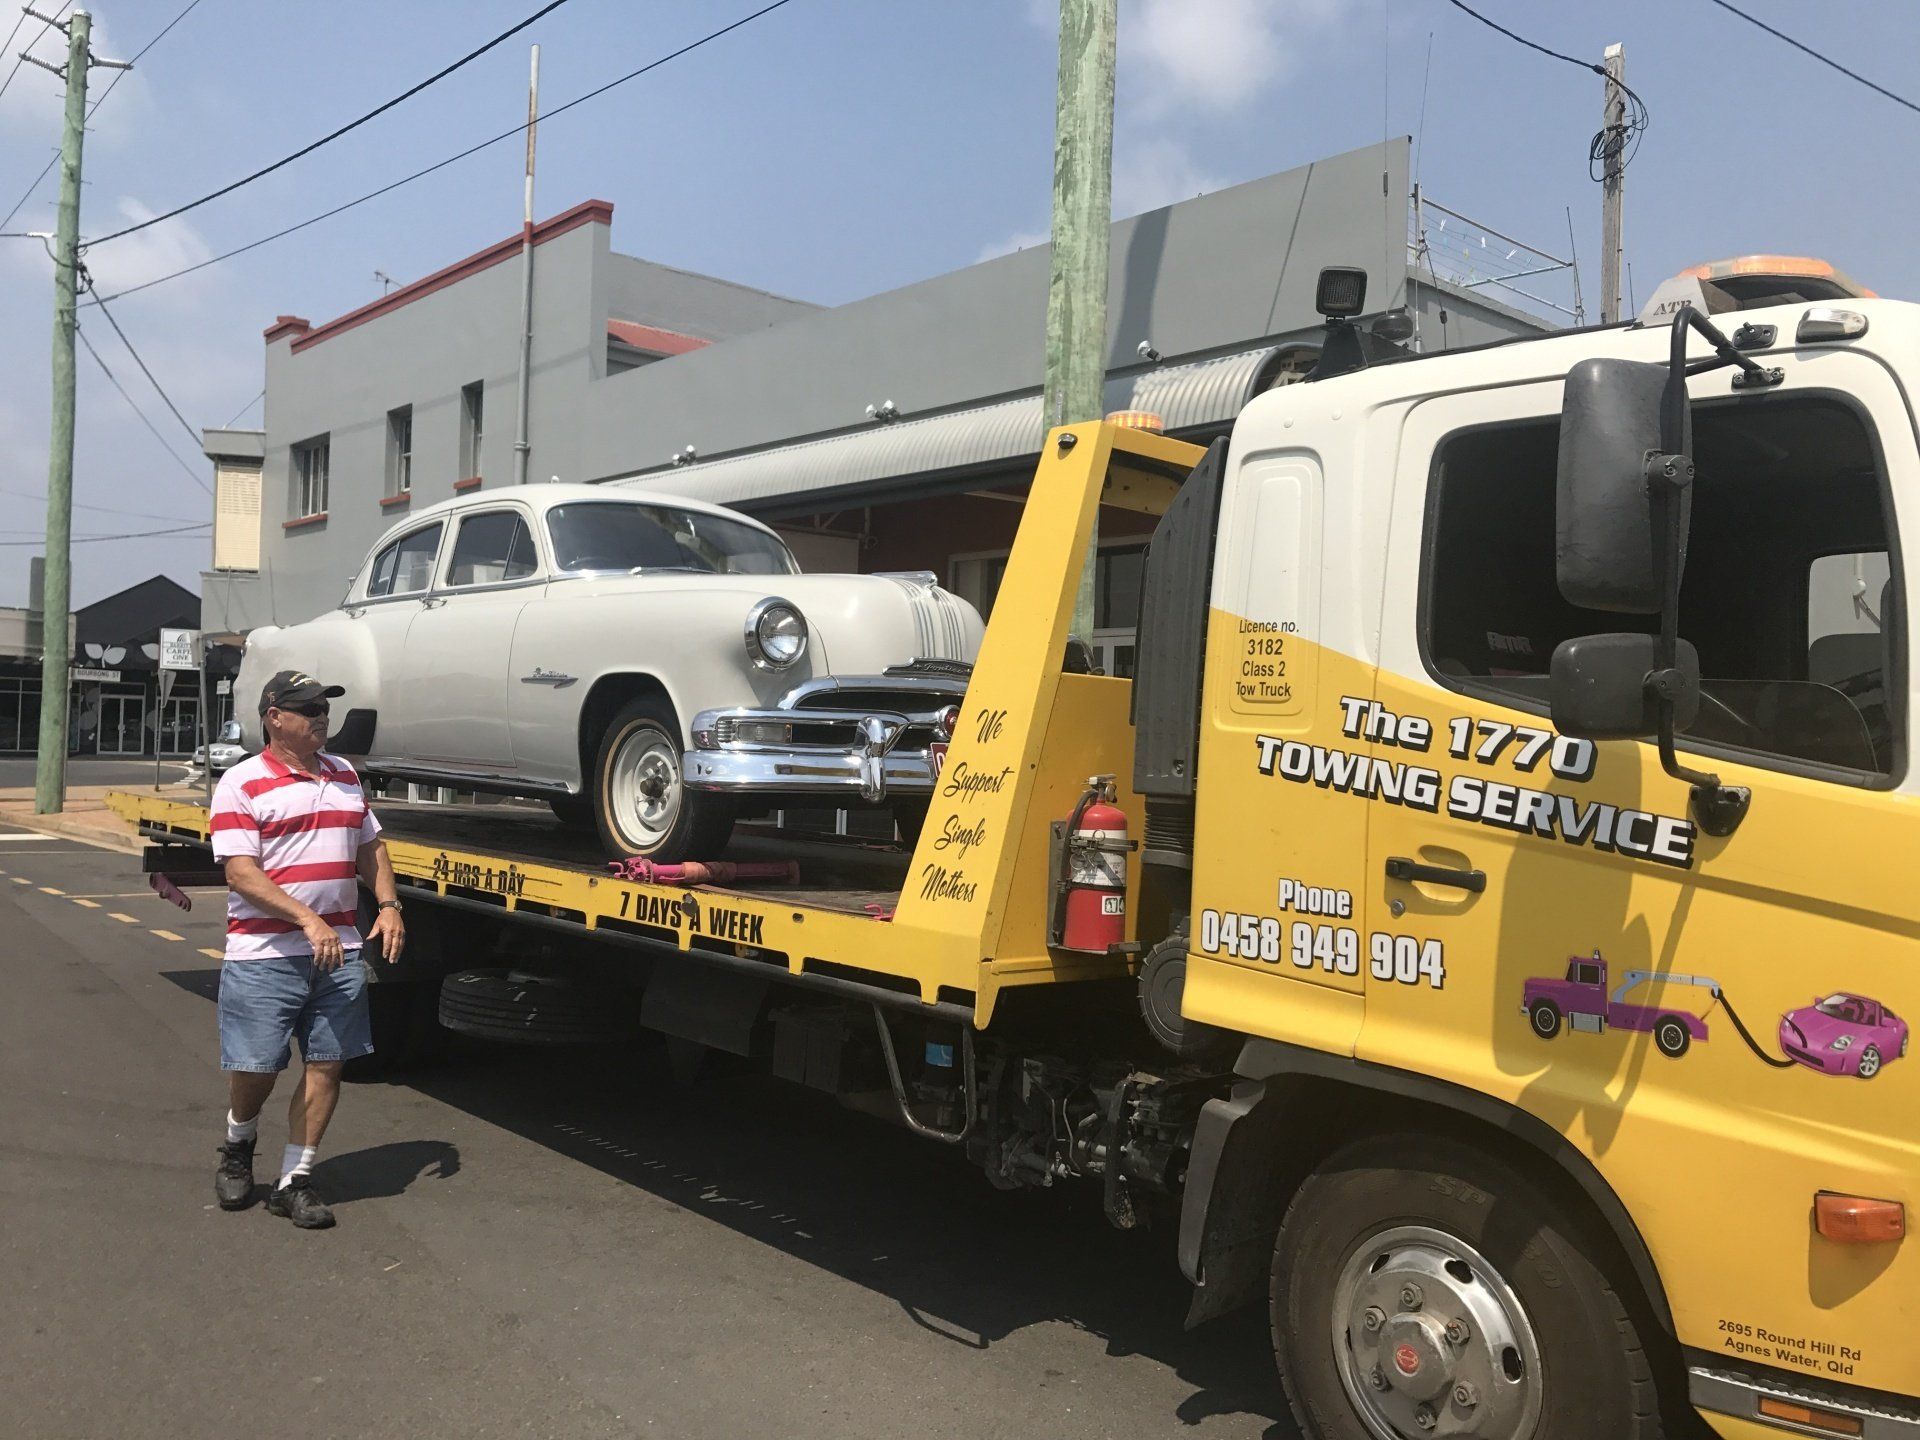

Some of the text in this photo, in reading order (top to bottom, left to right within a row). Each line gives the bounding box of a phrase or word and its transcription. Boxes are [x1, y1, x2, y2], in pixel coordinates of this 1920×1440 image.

[1239, 619, 1300, 633] Licence no.
[1248, 638, 1284, 655] 3182
[1242, 660, 1286, 676] Class 2
[1235, 681, 1292, 697] Tow Truck
[976, 708, 1008, 744] We
[1340, 695, 1598, 784] The 1770
[943, 761, 1015, 804] Support
[1256, 734, 1697, 870] TOWING SERVICE
[934, 814, 986, 860] Single
[432, 857, 526, 897] 24 HRS A DAY
[920, 863, 978, 903] Mothers
[620, 890, 630, 917] 7
[636, 896, 683, 928] DAYS
[709, 906, 765, 945] WEEK
[1278, 878, 1353, 918] Phone
[1200, 908, 1447, 989] 0458 949 904
[1718, 1319, 1862, 1362] 2695 Round Hill Rd
[1724, 1336, 1854, 1376] Agnes Water, Qld
